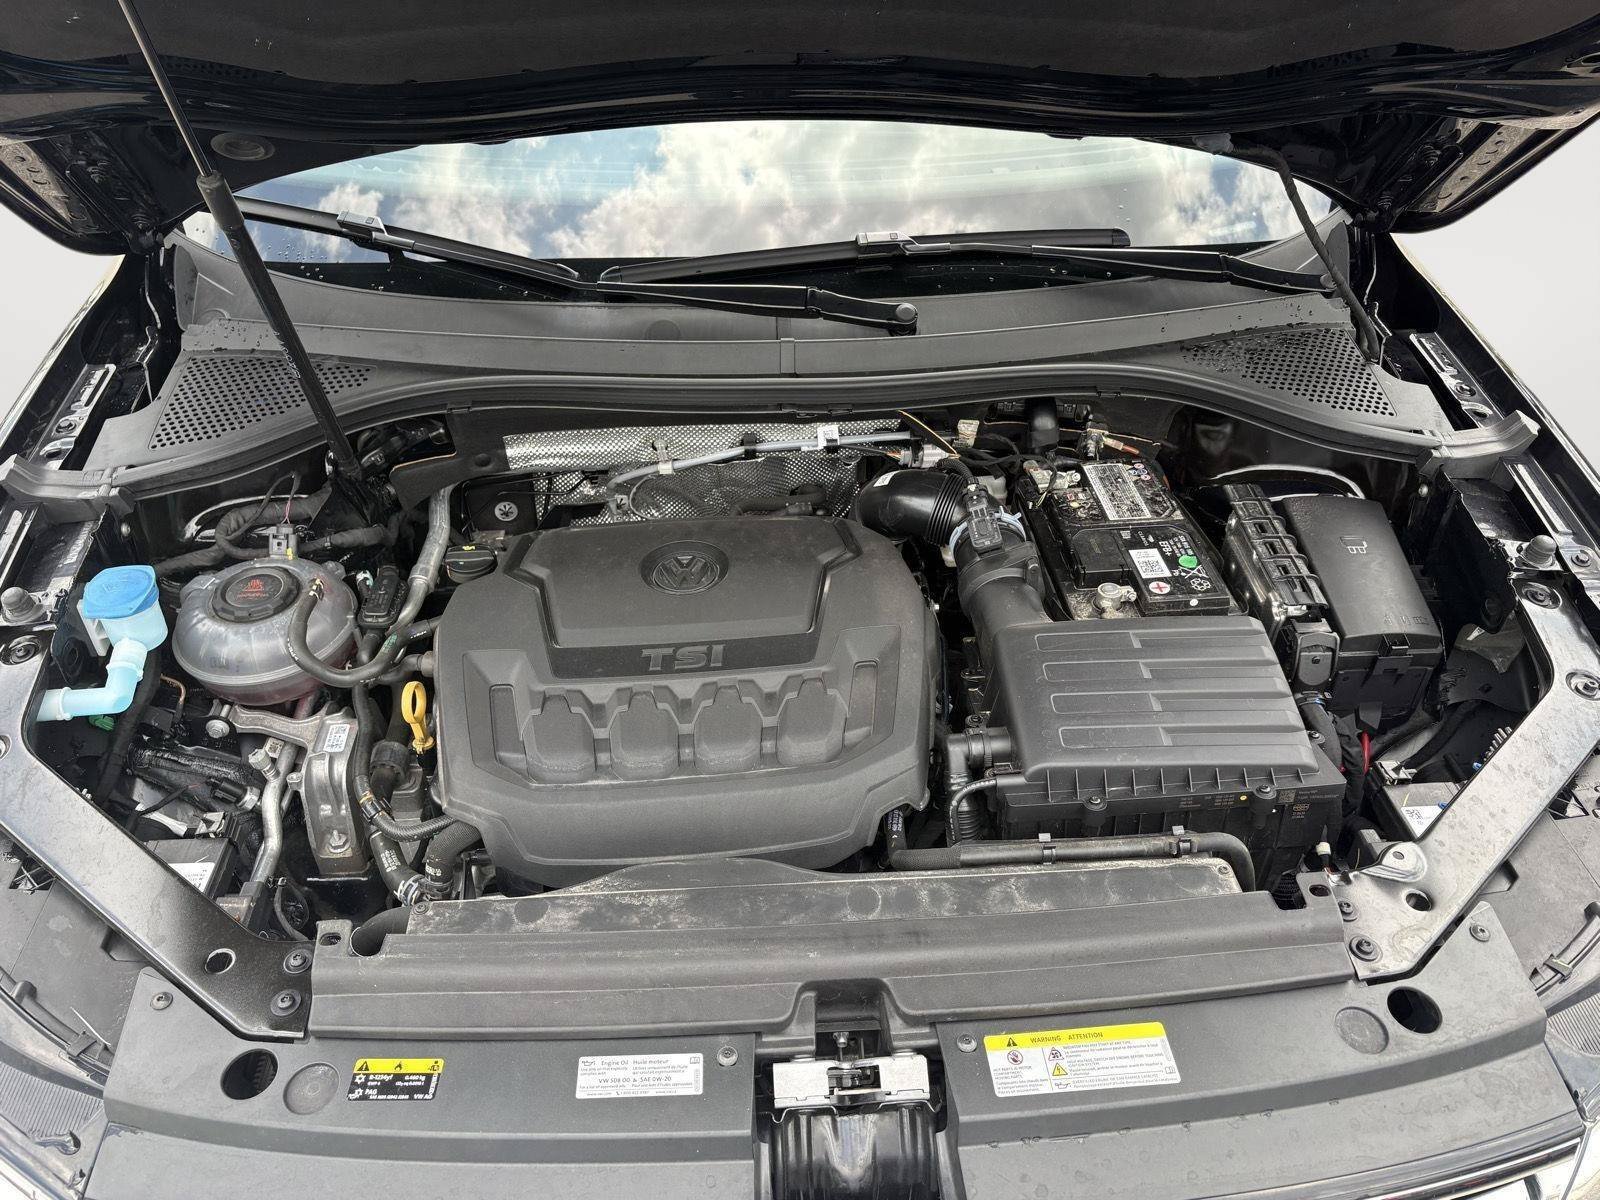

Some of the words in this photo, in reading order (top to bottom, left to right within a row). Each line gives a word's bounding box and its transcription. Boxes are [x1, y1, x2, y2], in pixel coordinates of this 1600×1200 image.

[641, 644, 726, 671] TSI
[1030, 1035, 1061, 1044] WARNING
[1068, 1032, 1104, 1041] ATTENTION
